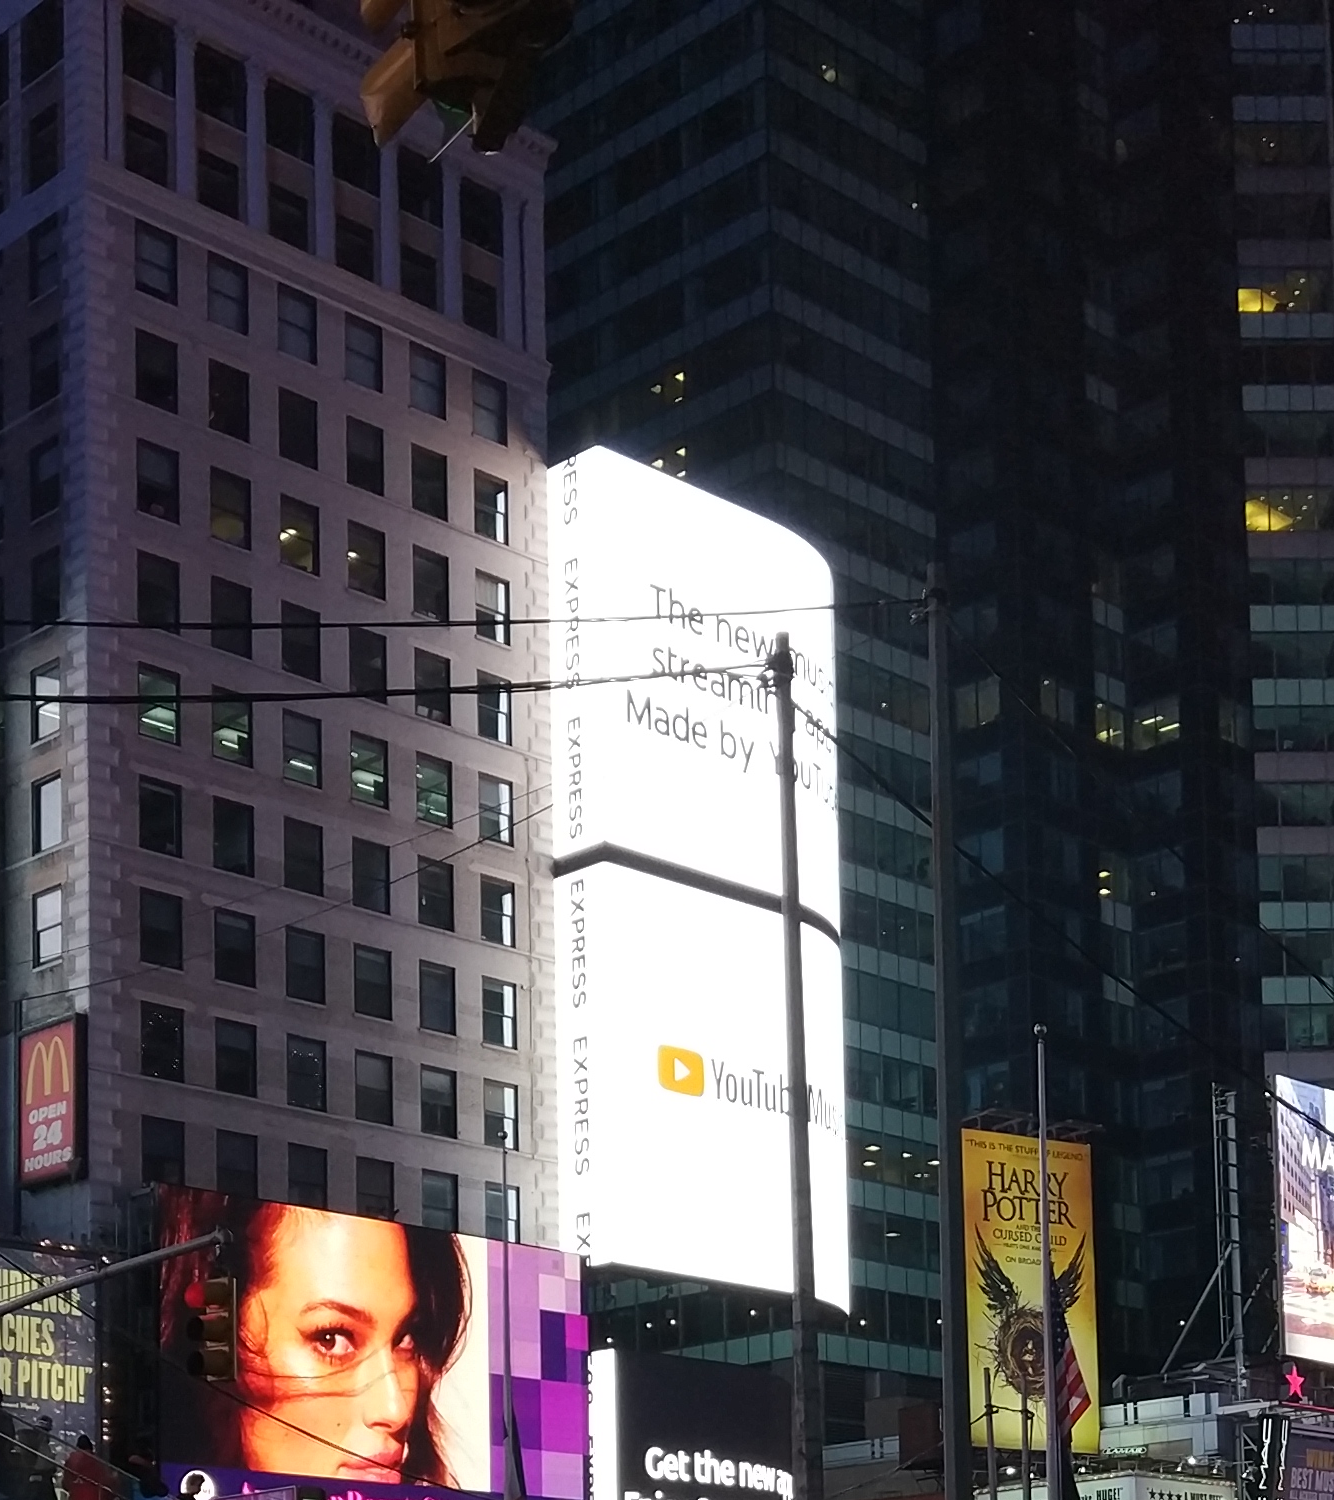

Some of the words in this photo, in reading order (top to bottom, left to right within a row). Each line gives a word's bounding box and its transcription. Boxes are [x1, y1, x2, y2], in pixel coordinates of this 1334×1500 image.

[564, 558, 580, 689] EXPRESS
[650, 583, 704, 636] The
[717, 614, 776, 658] new
[627, 690, 707, 750] Made
[720, 720, 754, 773] by
[567, 716, 583, 839] EXPRESS
[570, 878, 587, 1009] EXPRESS
[573, 1036, 590, 1176] EXPRESS
[711, 1059, 793, 1116] YouTub
[28, 1101, 66, 1125] OPEN
[33, 1120, 63, 1151] 24
[24, 1147, 73, 1173] HOURS
[988, 1141, 995, 1150] IS
[999, 1144, 1013, 1152] THE
[1015, 1145, 1039, 1155] STUFF
[981, 1189, 1077, 1229] POTTER
[992, 1228, 1032, 1243] CURSED
[1035, 1231, 1067, 1247] CILD
[18, 1359, 93, 1404] PITCH!"
[645, 1446, 691, 1482] Get
[694, 1450, 736, 1487] the
[739, 1461, 775, 1492] new
[1290, 1467, 1313, 1490] BEST
